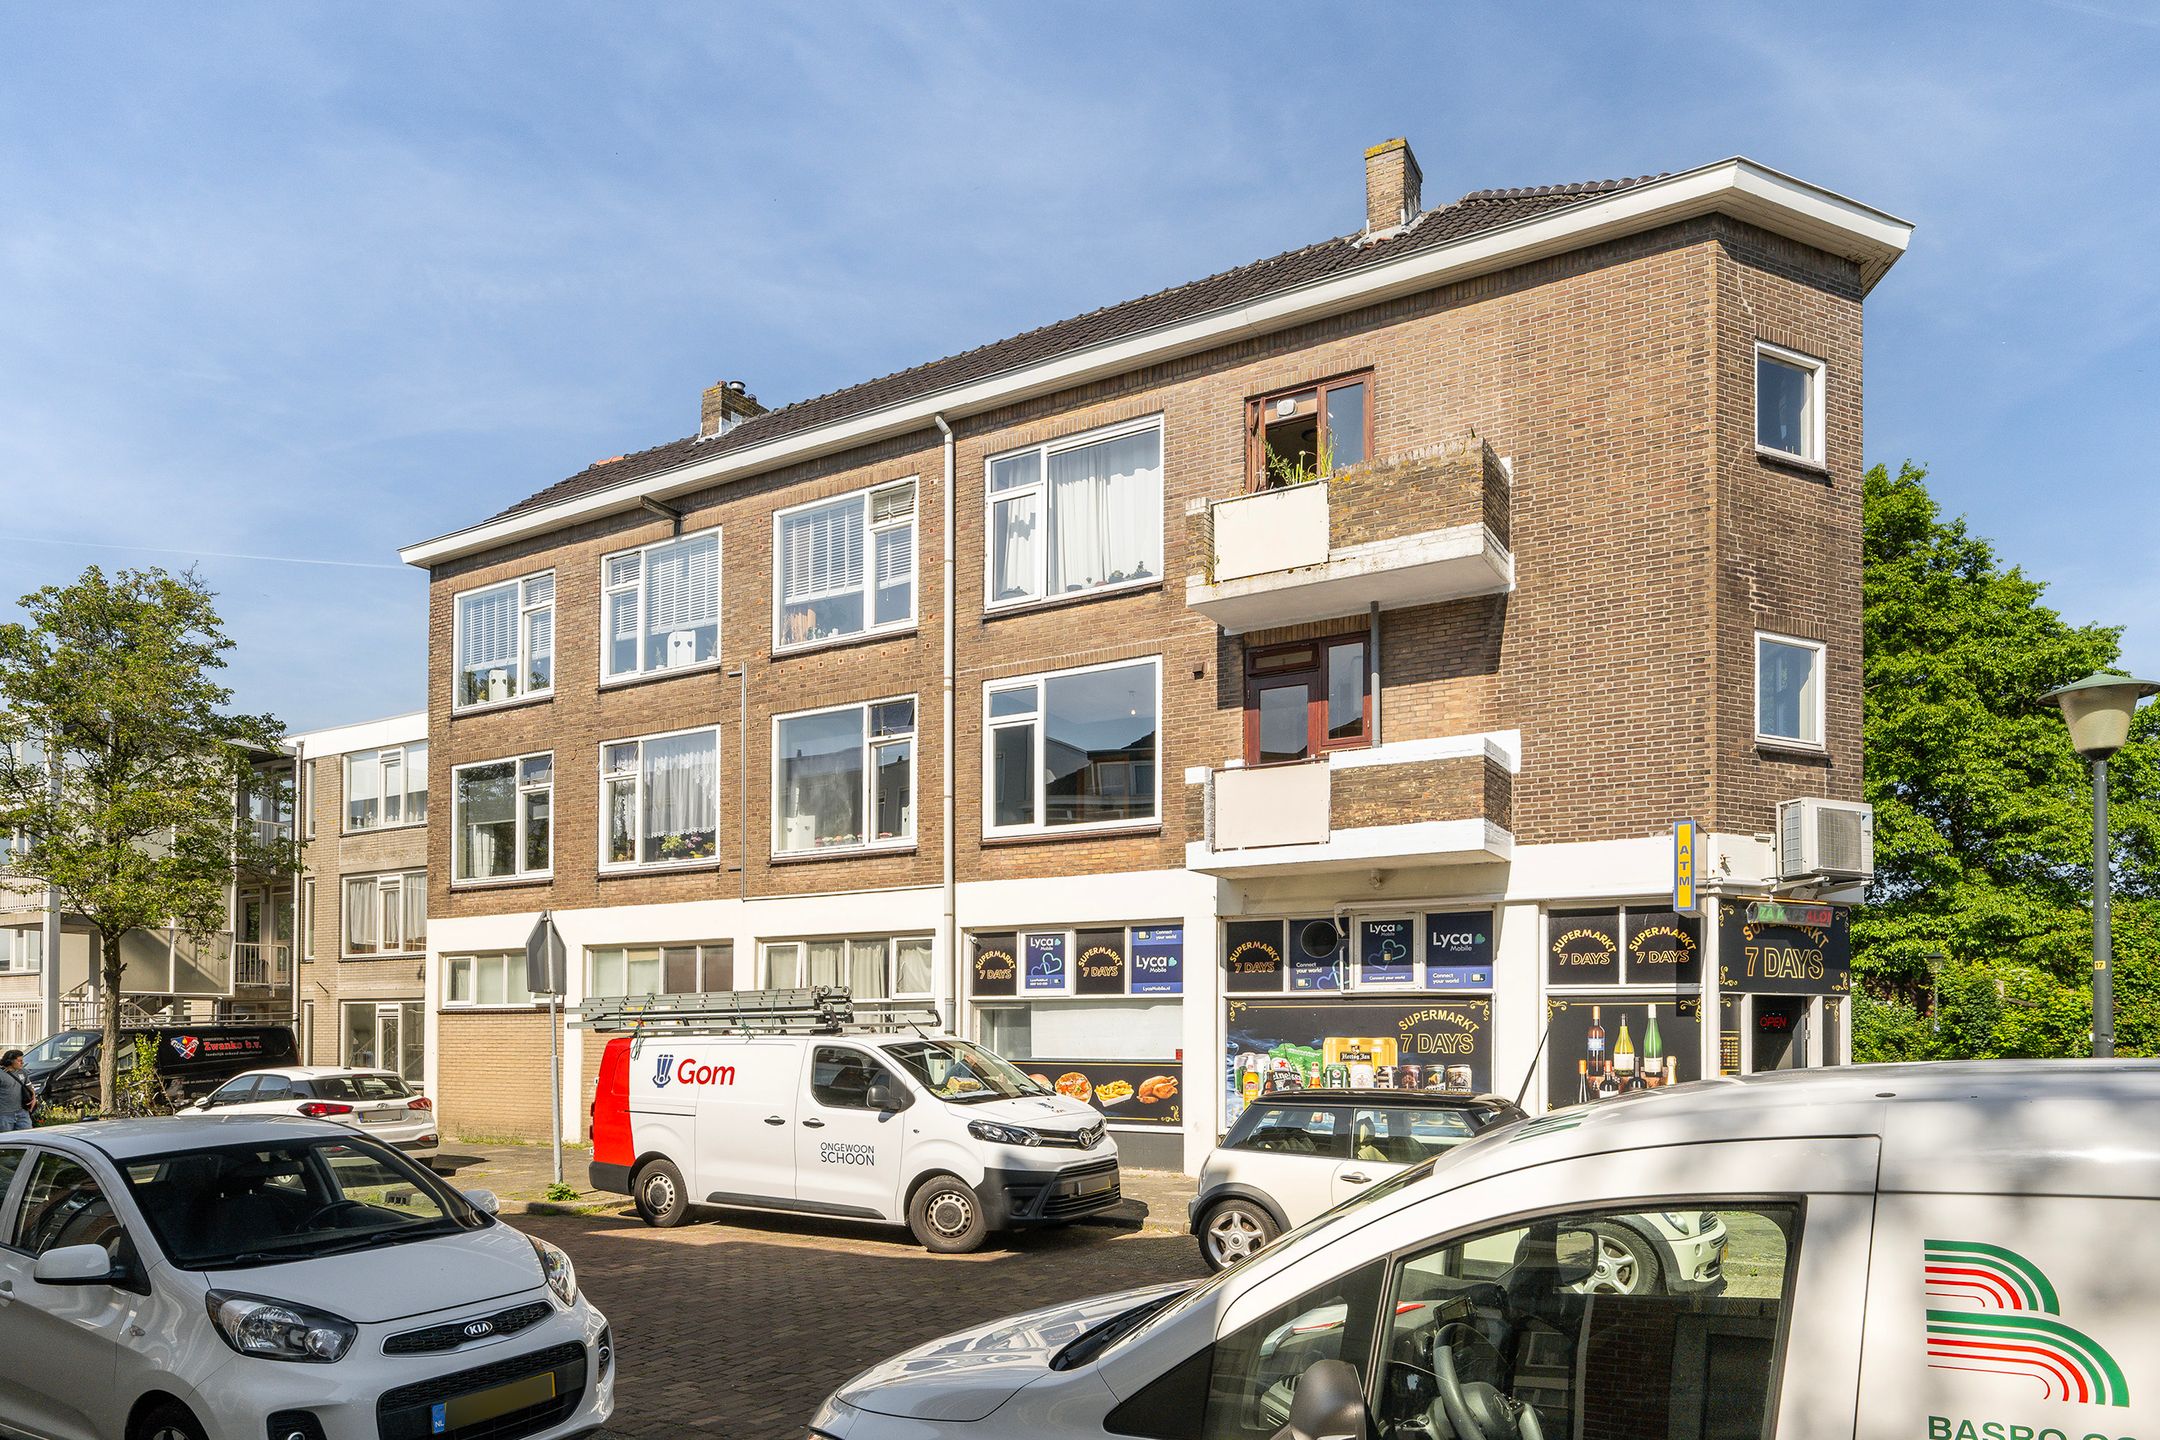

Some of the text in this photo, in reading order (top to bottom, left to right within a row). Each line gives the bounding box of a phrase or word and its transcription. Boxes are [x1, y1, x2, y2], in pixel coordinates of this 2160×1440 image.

[1679, 845, 1690, 886] ATM
[1369, 923, 1396, 934] Lyca
[1030, 937, 1054, 948] Lyca
[1432, 932, 1473, 948] Lyca
[1552, 928, 1617, 954] SUPERMARKT
[1628, 926, 1697, 952] SUPERMARKT
[975, 950, 1016, 970] SUPERMARKT
[1078, 946, 1123, 968] SUPERMARKT
[1229, 941, 1281, 964] SUPERMARKT
[1558, 951, 1611, 966] 7 DAYS
[1635, 949, 1690, 964] 7 DAYS
[1136, 955, 1167, 970] Lyca
[1234, 961, 1275, 974] 7 DAYS
[1744, 947, 1824, 980] 7 DAYS
[979, 969, 1012, 980] 7 DAYS
[1082, 965, 1119, 978] 7 DAYS
[1398, 1009, 1480, 1034] SUPERMARKT
[1759, 1016, 1787, 1027] OPEN
[203, 1040, 262, 1051] Zwanko b.v.
[1400, 1033, 1474, 1054] 7 DAYS
[677, 1058, 736, 1086] Gom
[820, 1141, 875, 1154] ONGEWOON
[820, 1151, 875, 1166] SCHOON
[469, 1323, 490, 1335] KIA
